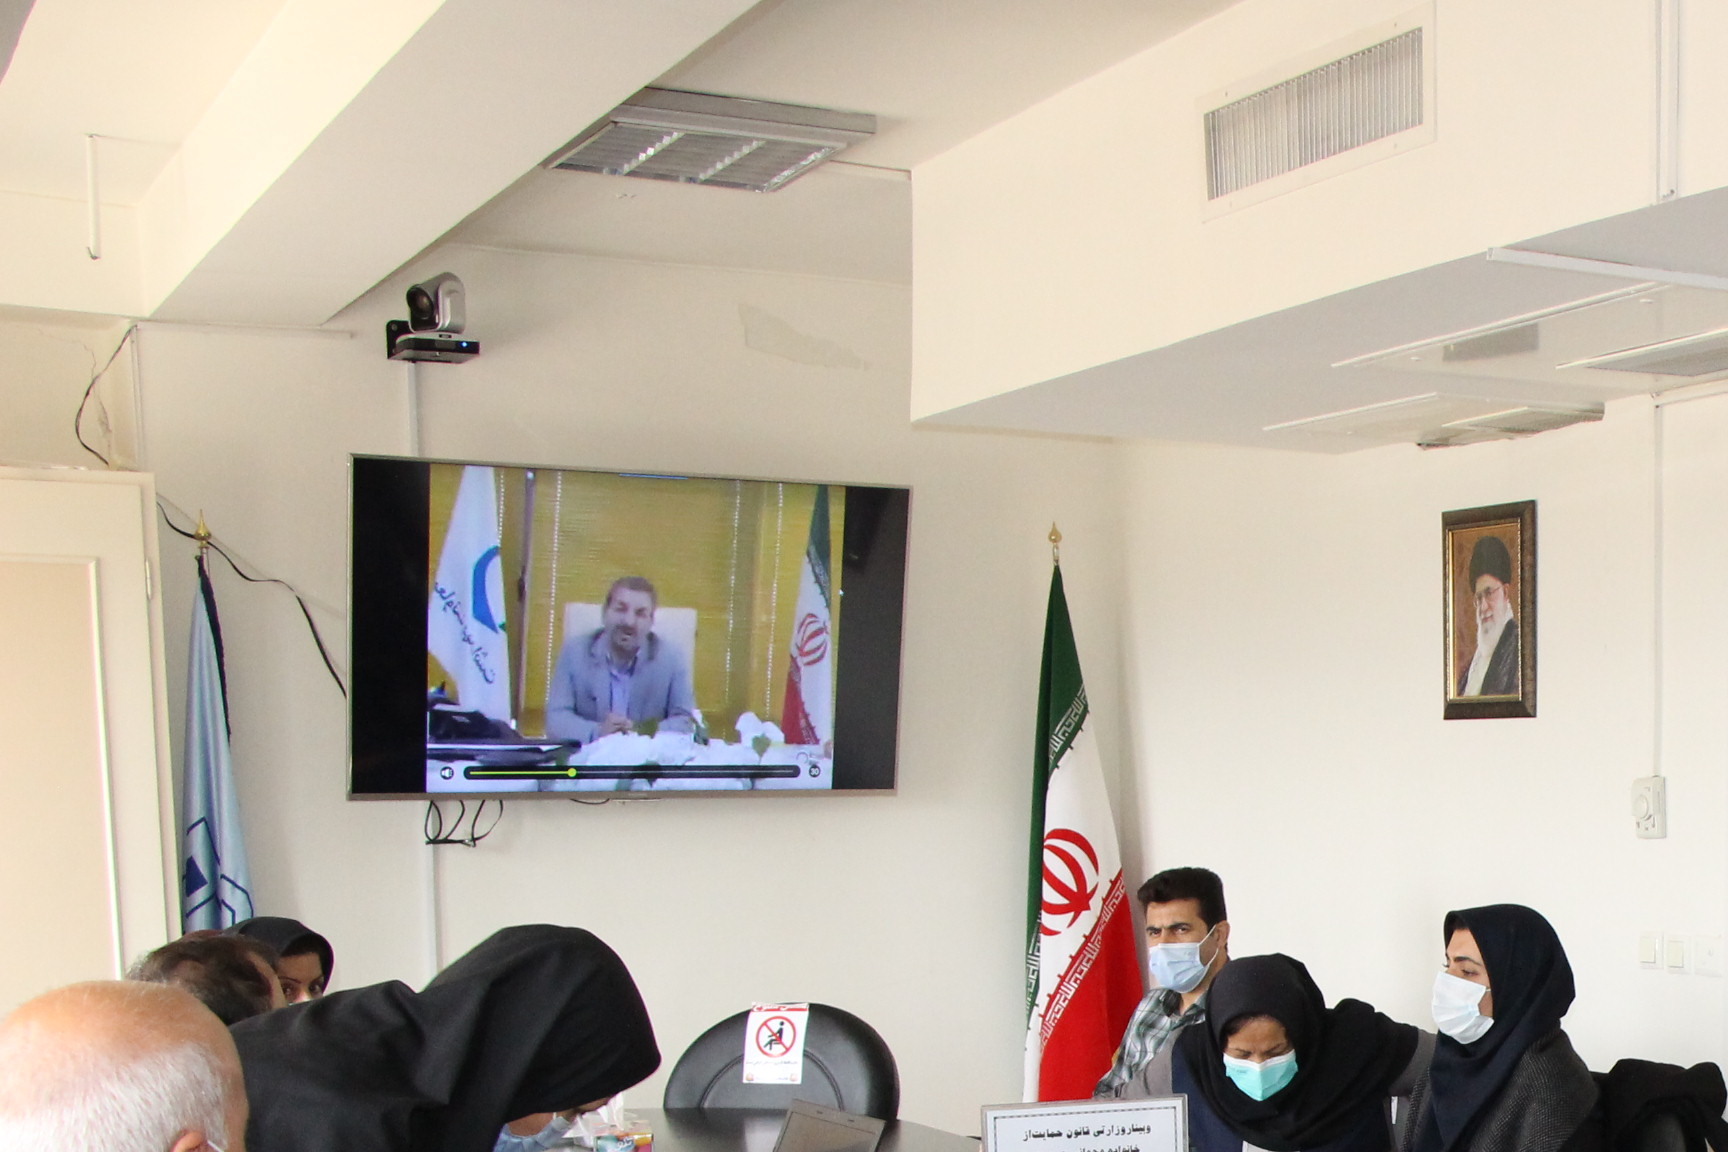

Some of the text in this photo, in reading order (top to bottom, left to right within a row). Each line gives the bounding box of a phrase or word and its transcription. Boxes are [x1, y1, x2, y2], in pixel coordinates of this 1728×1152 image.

[1032, 1128, 1063, 1140] حمایت
[1066, 1125, 1090, 1139] قانون
[1093, 1124, 1126, 1137] وزارتی
[1126, 1122, 1151, 1136] وبینار
